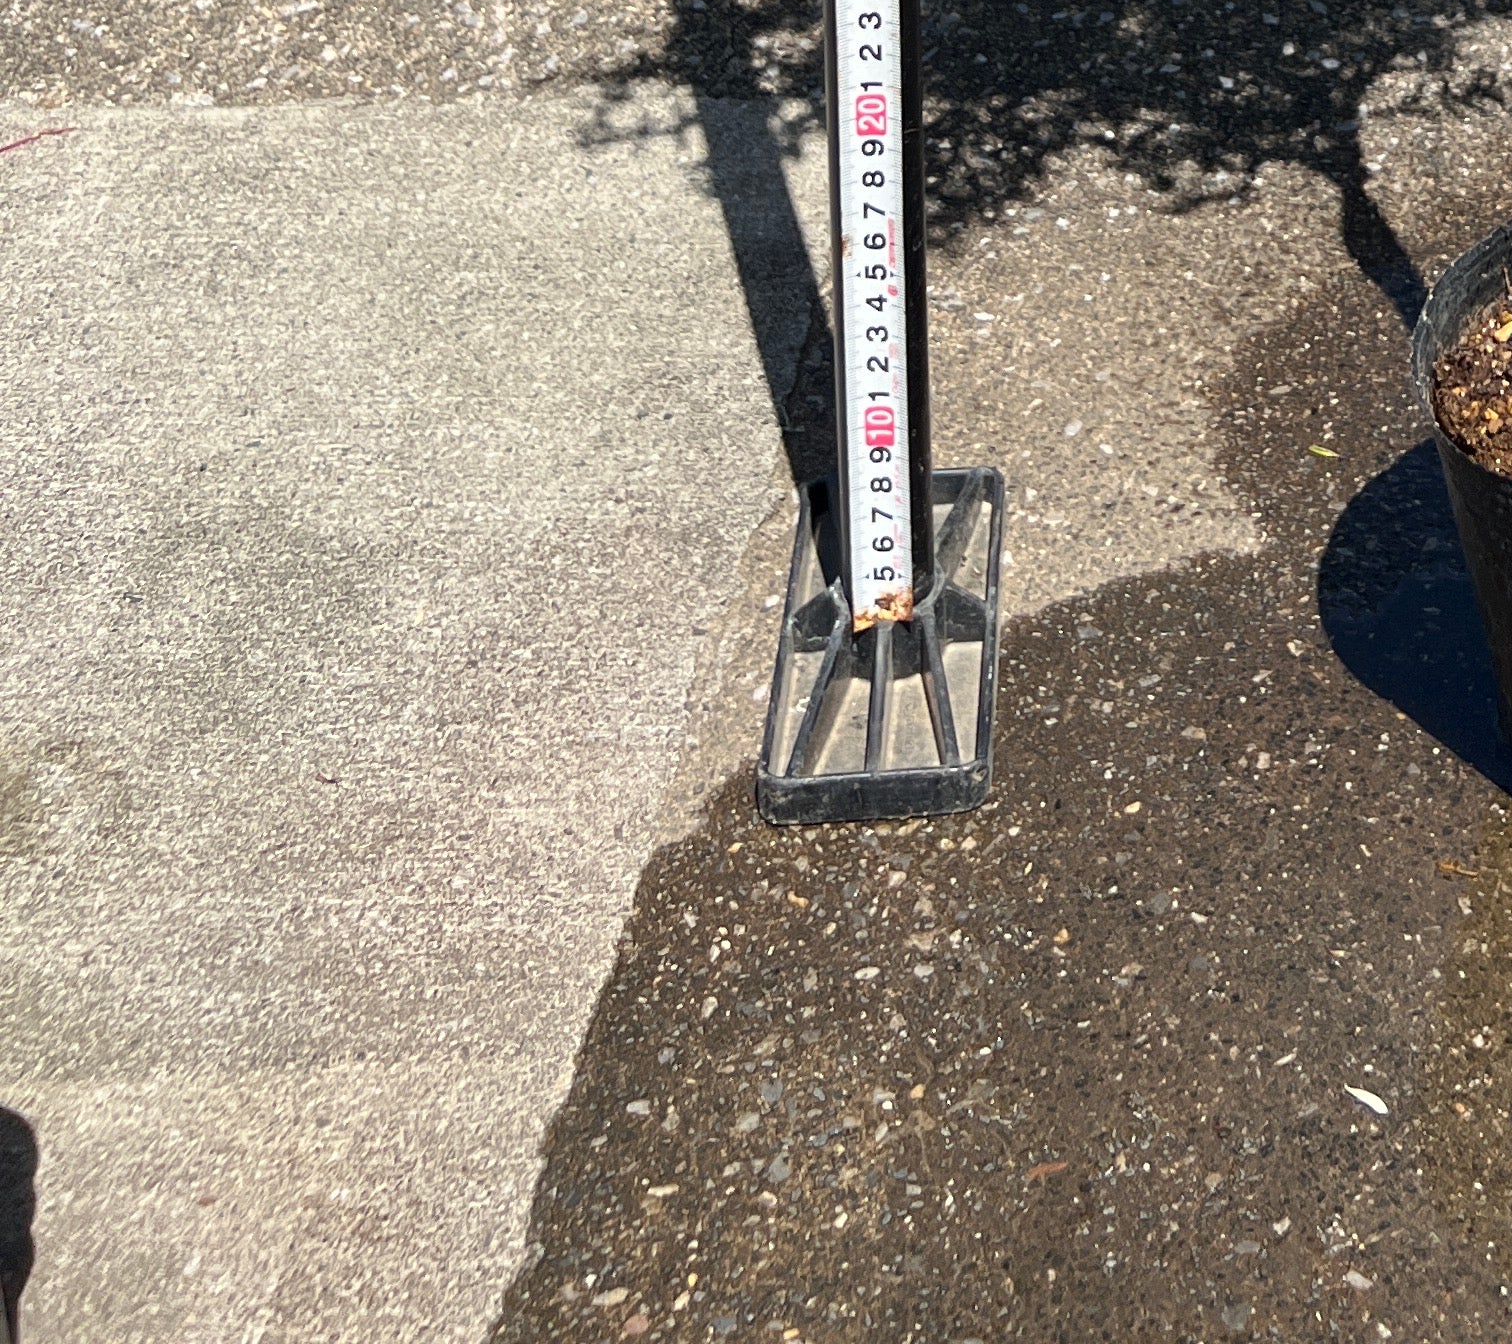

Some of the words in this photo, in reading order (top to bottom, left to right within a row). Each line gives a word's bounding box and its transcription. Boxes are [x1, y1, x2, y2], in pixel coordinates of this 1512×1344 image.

[859, 12, 881, 29] 3
[859, 45, 882, 61] 2
[861, 82, 882, 91] 1
[858, 99, 884, 130] 20
[862, 140, 884, 156] 9
[863, 171, 884, 187] 8
[864, 203, 885, 218] 7
[864, 233, 886, 249] 6
[865, 265, 887, 280] 5
[866, 295, 887, 311] 4
[866, 326, 888, 342] 3
[867, 357, 888, 372] 2
[868, 392, 889, 401] 1
[867, 411, 893, 440] 10
[870, 446, 891, 464] 9
[871, 477, 892, 492] 8
[872, 507, 893, 522] 7
[872, 536, 894, 552] 6
[874, 566, 895, 581] 5
